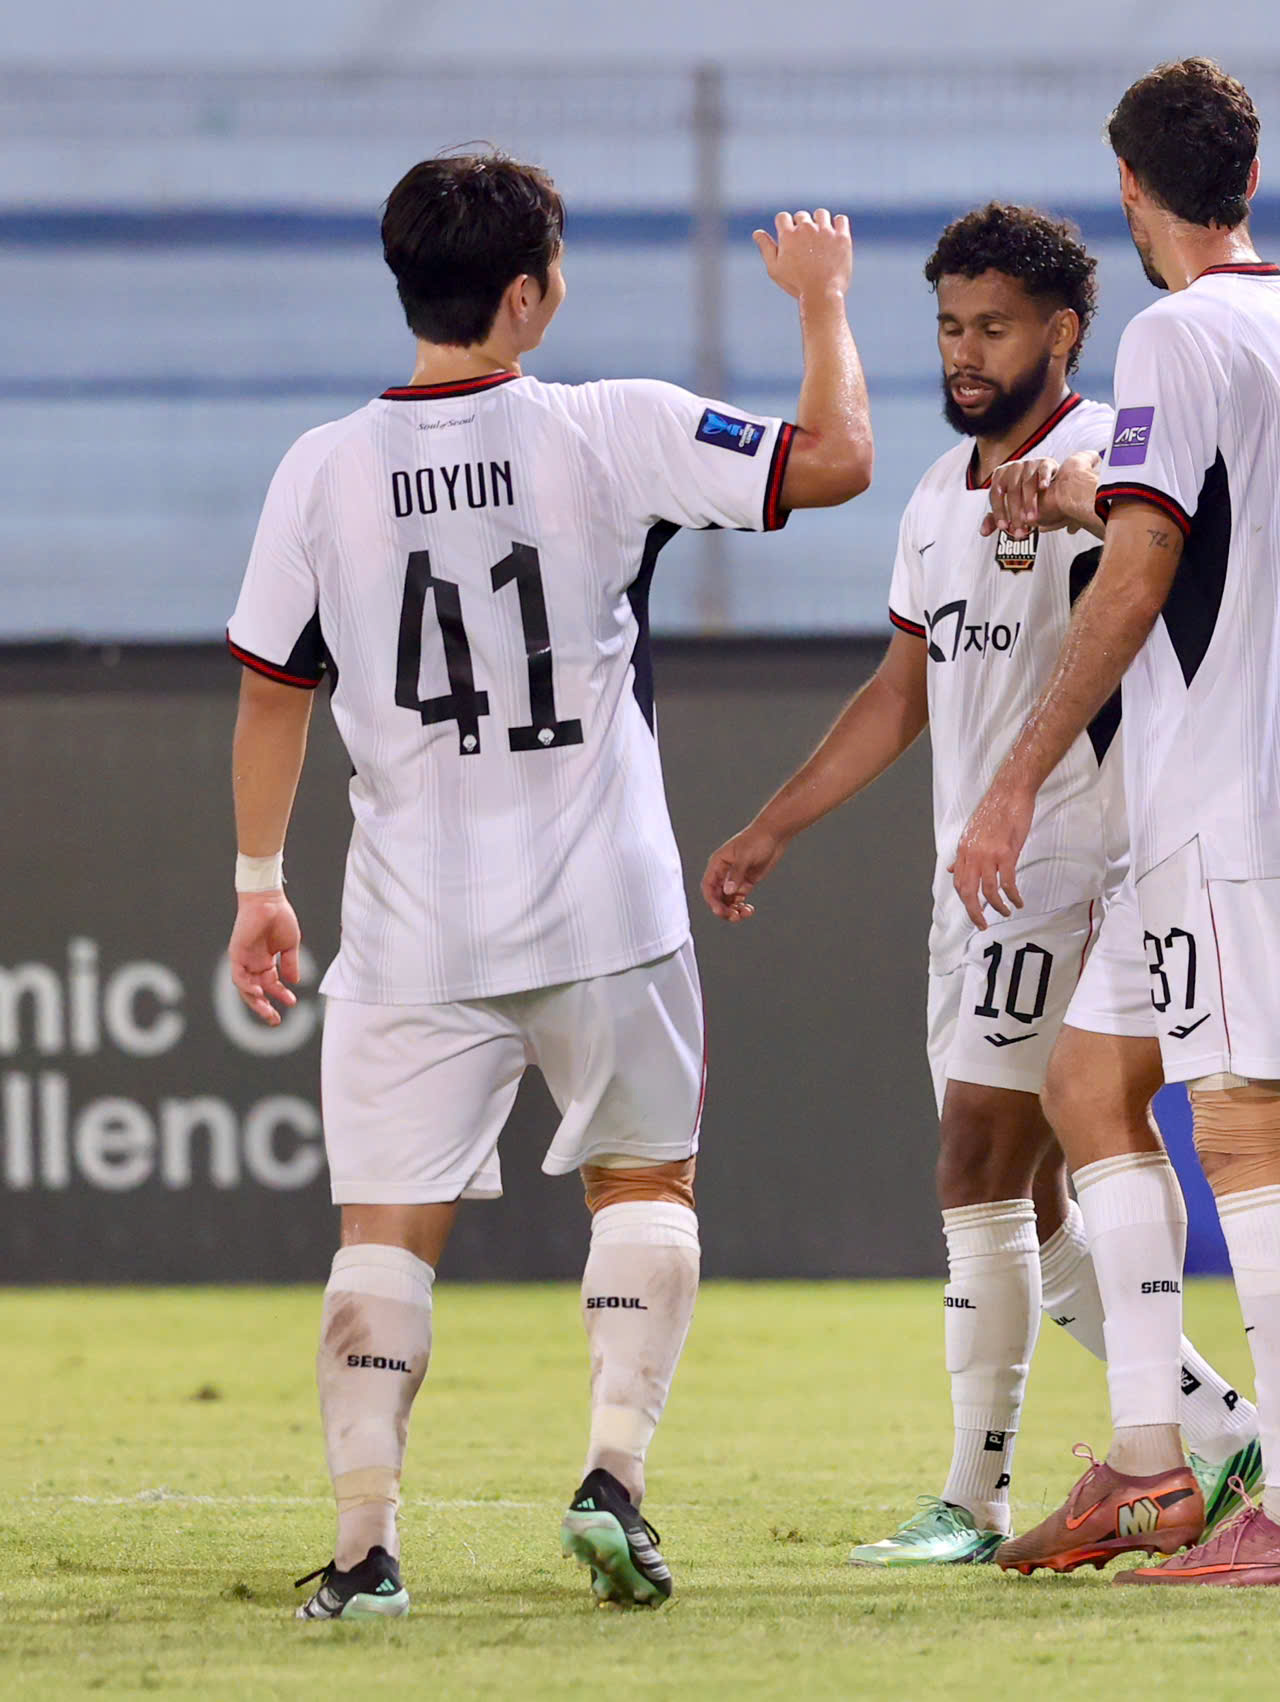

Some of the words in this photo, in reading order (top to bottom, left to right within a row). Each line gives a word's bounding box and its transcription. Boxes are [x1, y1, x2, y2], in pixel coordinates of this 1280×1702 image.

[1114, 426, 1150, 443] AFC
[391, 460, 514, 518] DOYUN
[395, 541, 584, 755] 41
[974, 941, 1054, 1024] 10
[1143, 927, 1197, 1012] 37
[586, 1296, 648, 1310] SEOUL
[943, 1296, 977, 1309] OUL
[347, 1354, 412, 1373] SEOUL
